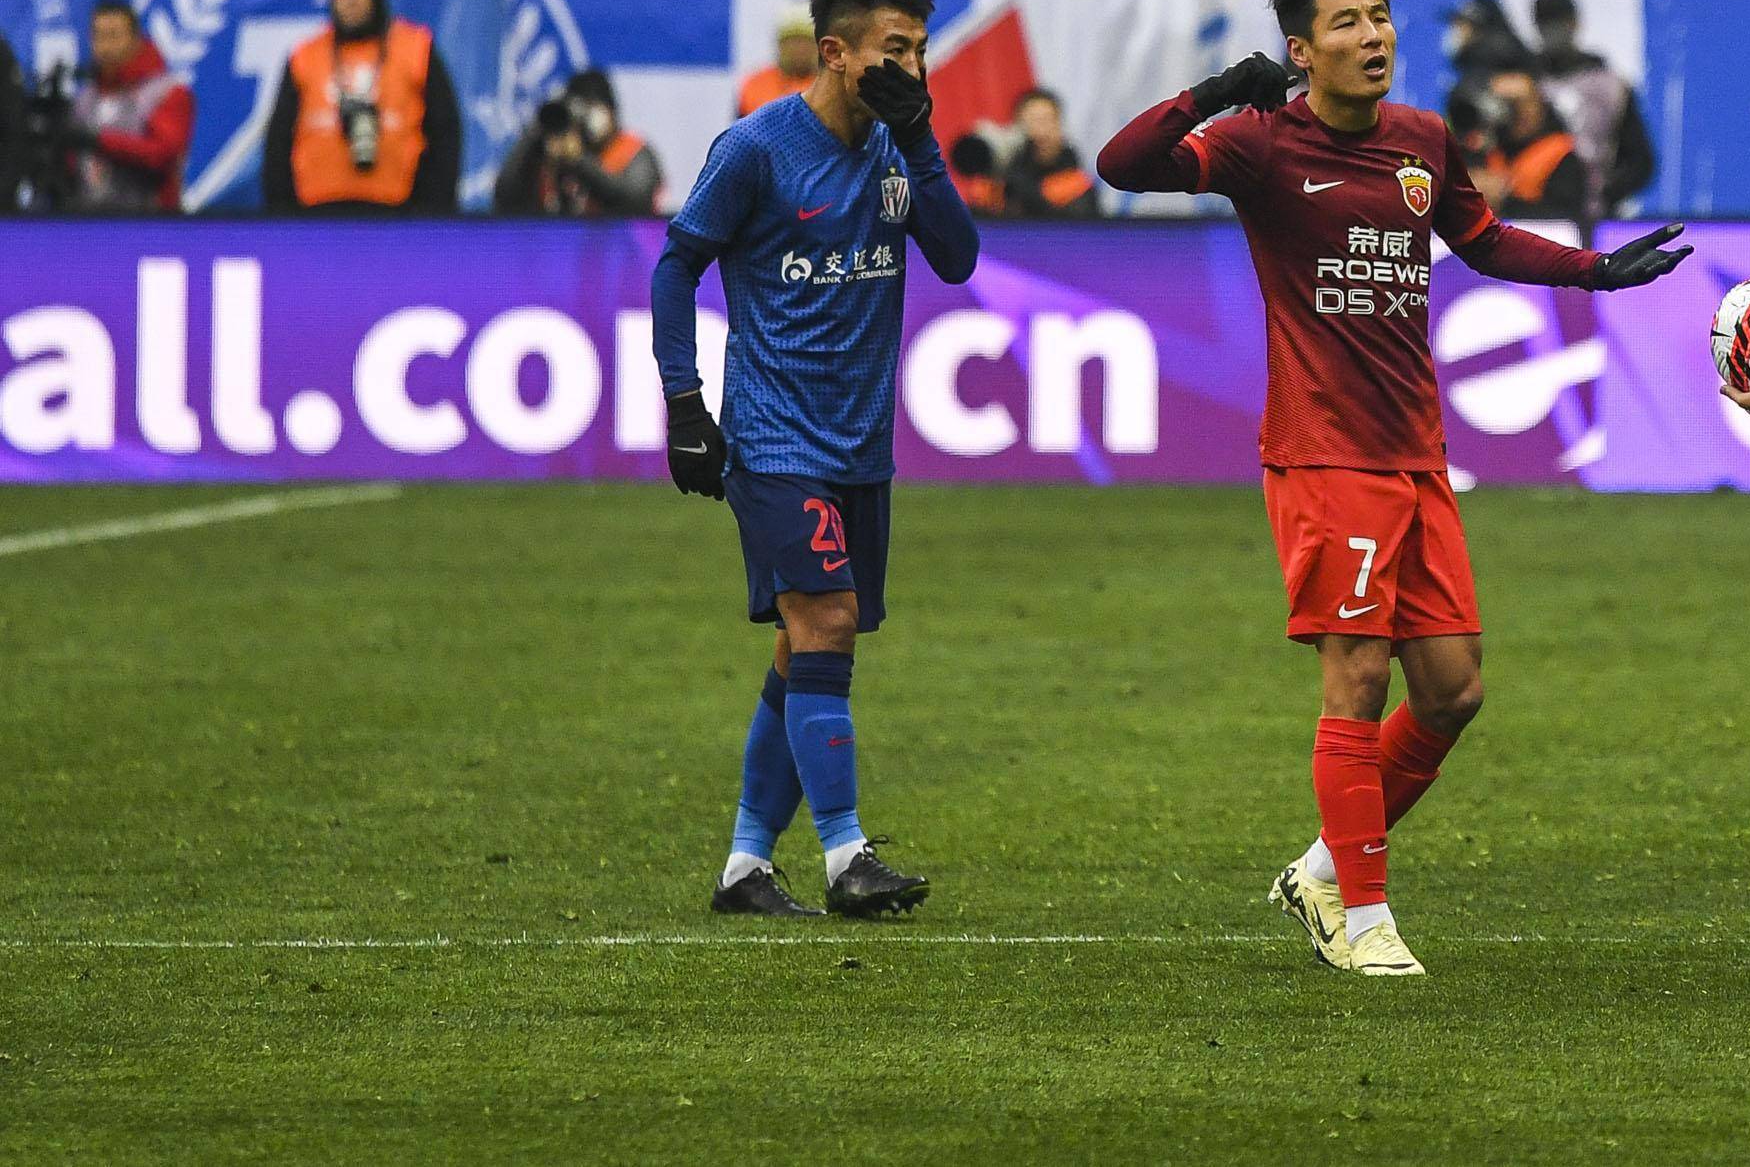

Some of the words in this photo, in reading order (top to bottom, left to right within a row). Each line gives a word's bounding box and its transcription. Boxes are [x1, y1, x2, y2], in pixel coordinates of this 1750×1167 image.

[1348, 226, 1413, 258] 荣威
[813, 276, 841, 284] BANK
[1317, 258, 1429, 286] ROEWE
[1348, 537, 1377, 598] 7
